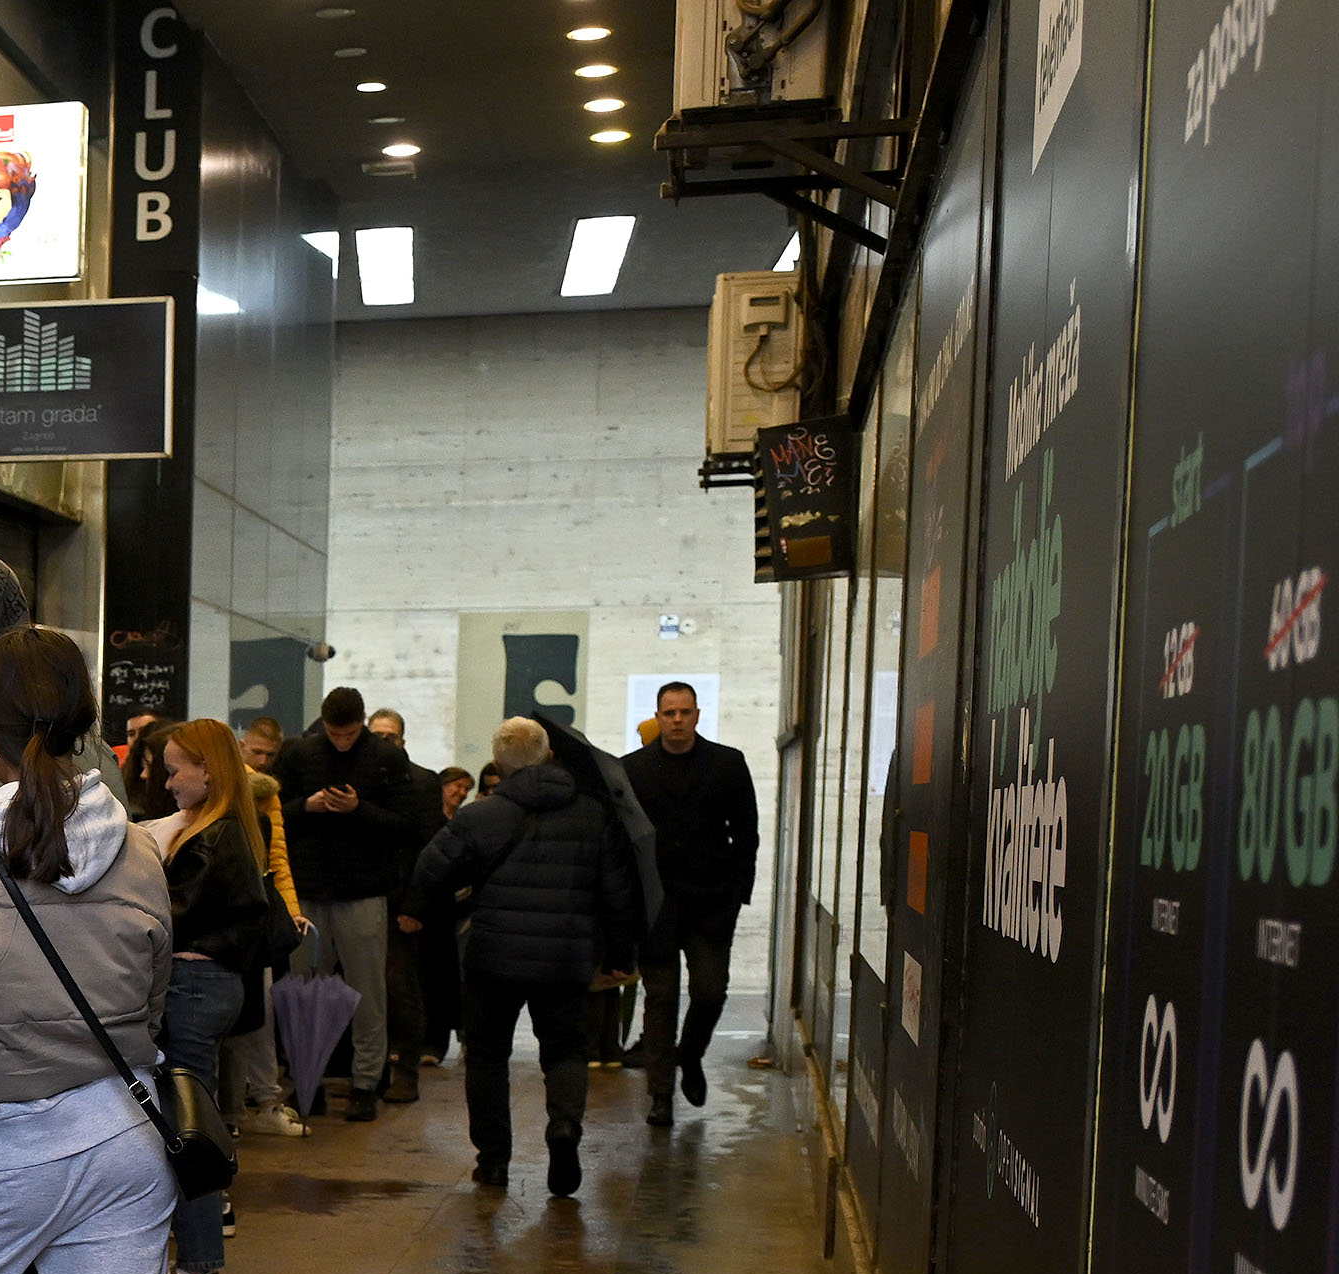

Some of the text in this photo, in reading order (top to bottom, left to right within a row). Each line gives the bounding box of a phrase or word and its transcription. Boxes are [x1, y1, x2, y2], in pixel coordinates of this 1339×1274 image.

[135, 8, 178, 242] CLUB
[41, 404, 98, 428] grada
[982, 706, 1067, 964] kvalitete
[1140, 723, 1206, 872] 20 GB
[1237, 699, 1339, 888] 80 GB
[997, 1128, 1040, 1229] OPENSIGNAL
